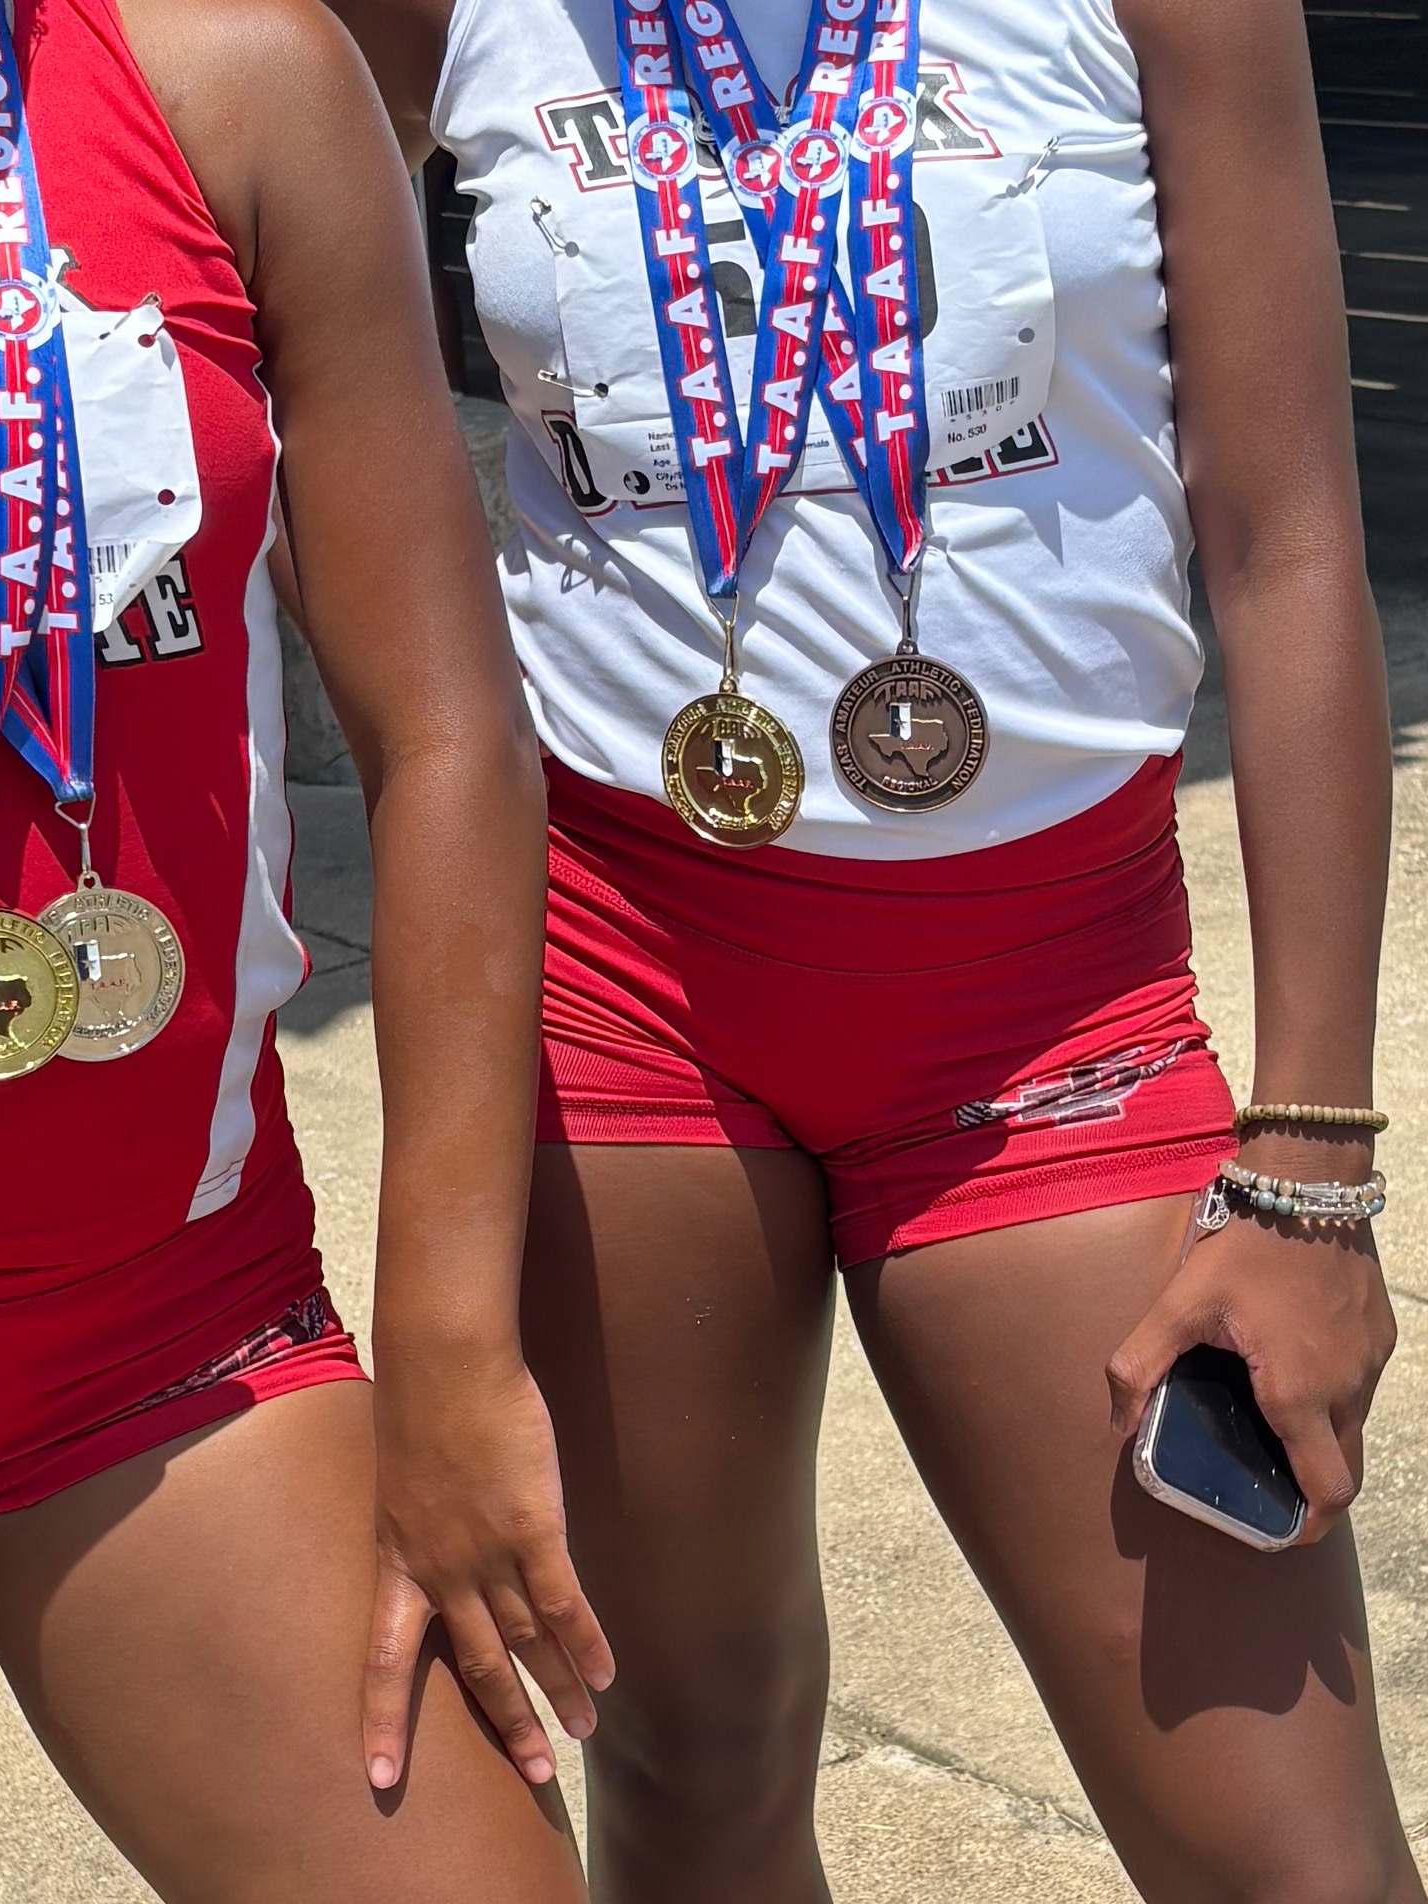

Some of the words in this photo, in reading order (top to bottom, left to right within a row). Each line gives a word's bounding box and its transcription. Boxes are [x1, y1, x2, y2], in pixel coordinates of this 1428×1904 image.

[653, 203, 732, 467] T.A.A.F.
[756, 214, 825, 475] T.A.A.F.
[861, 172, 915, 442] T.A.A.F.
[834, 668, 881, 733] AMATEUR
[891, 660, 962, 693] ATHLETIC
[835, 743, 869, 791] TEXAS
[951, 697, 984, 791] FEDERATION
